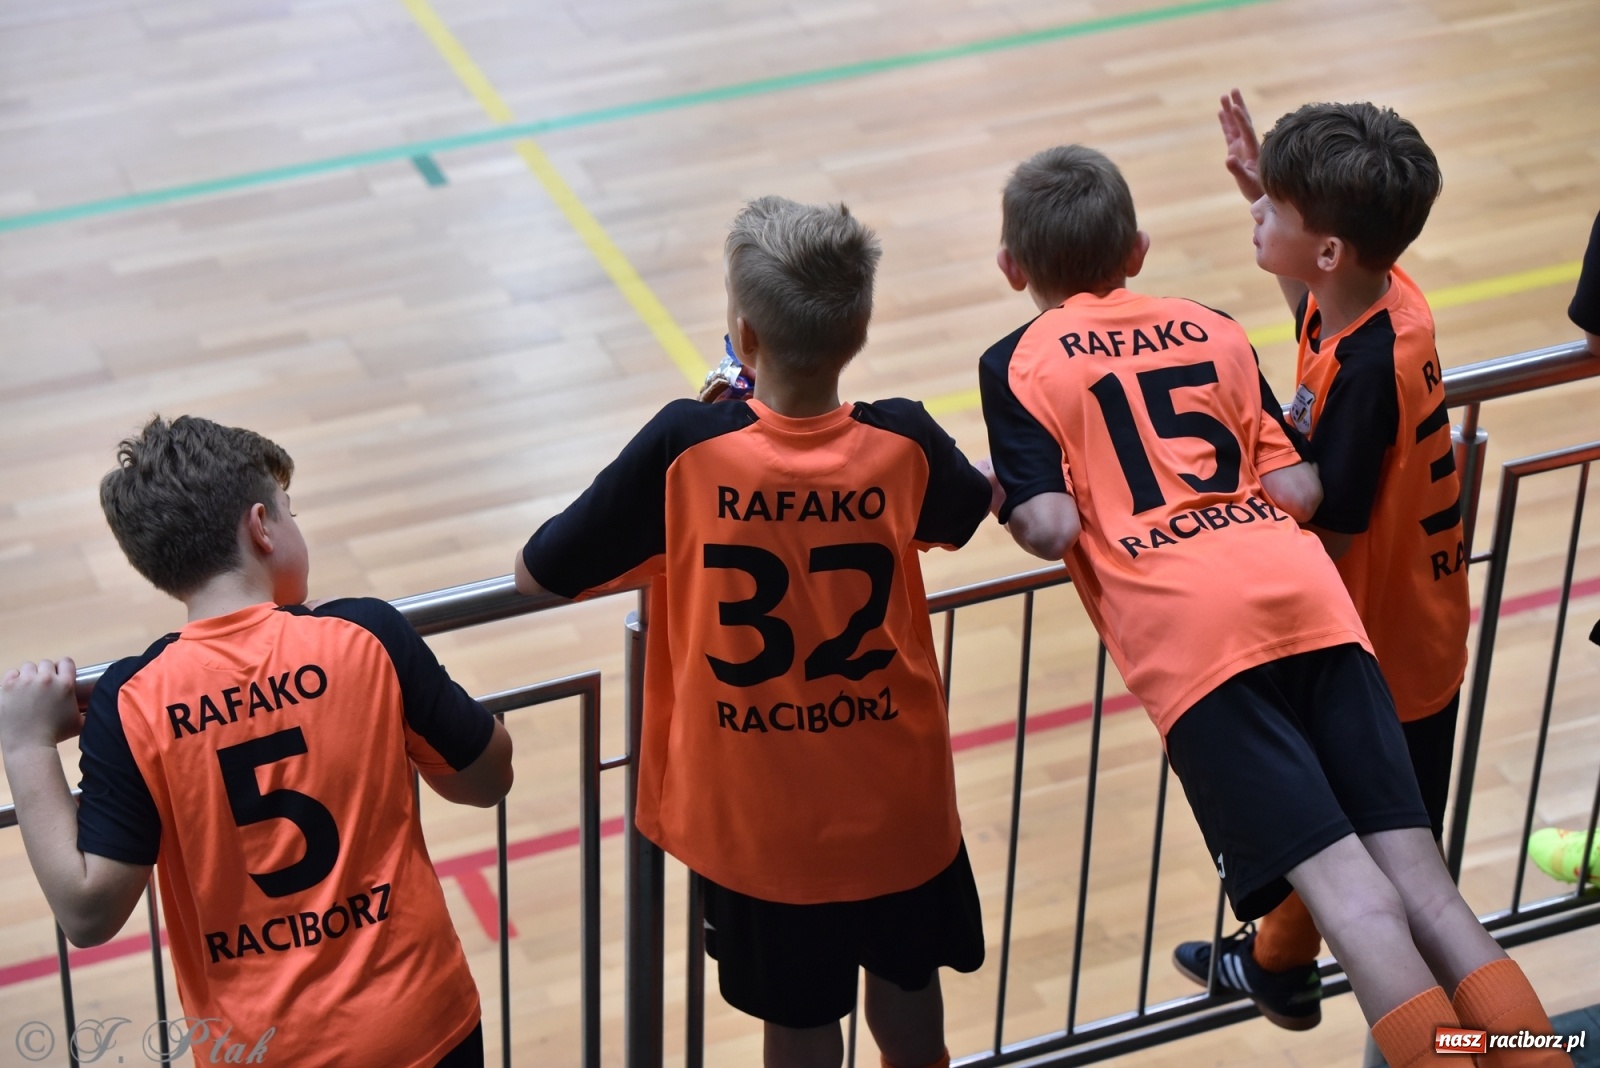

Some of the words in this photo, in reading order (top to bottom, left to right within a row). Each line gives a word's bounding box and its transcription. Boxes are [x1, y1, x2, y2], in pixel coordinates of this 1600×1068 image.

[1059, 320, 1209, 358] RAFAKO
[1088, 361, 1242, 516] 15
[717, 486, 886, 522] RAFAKO
[703, 542, 898, 688] 32
[166, 664, 328, 740] RAFAKO
[716, 686, 899, 733] RACIBÓRZ
[217, 727, 340, 899] 5
[205, 883, 391, 964] RACIBÓRZ
